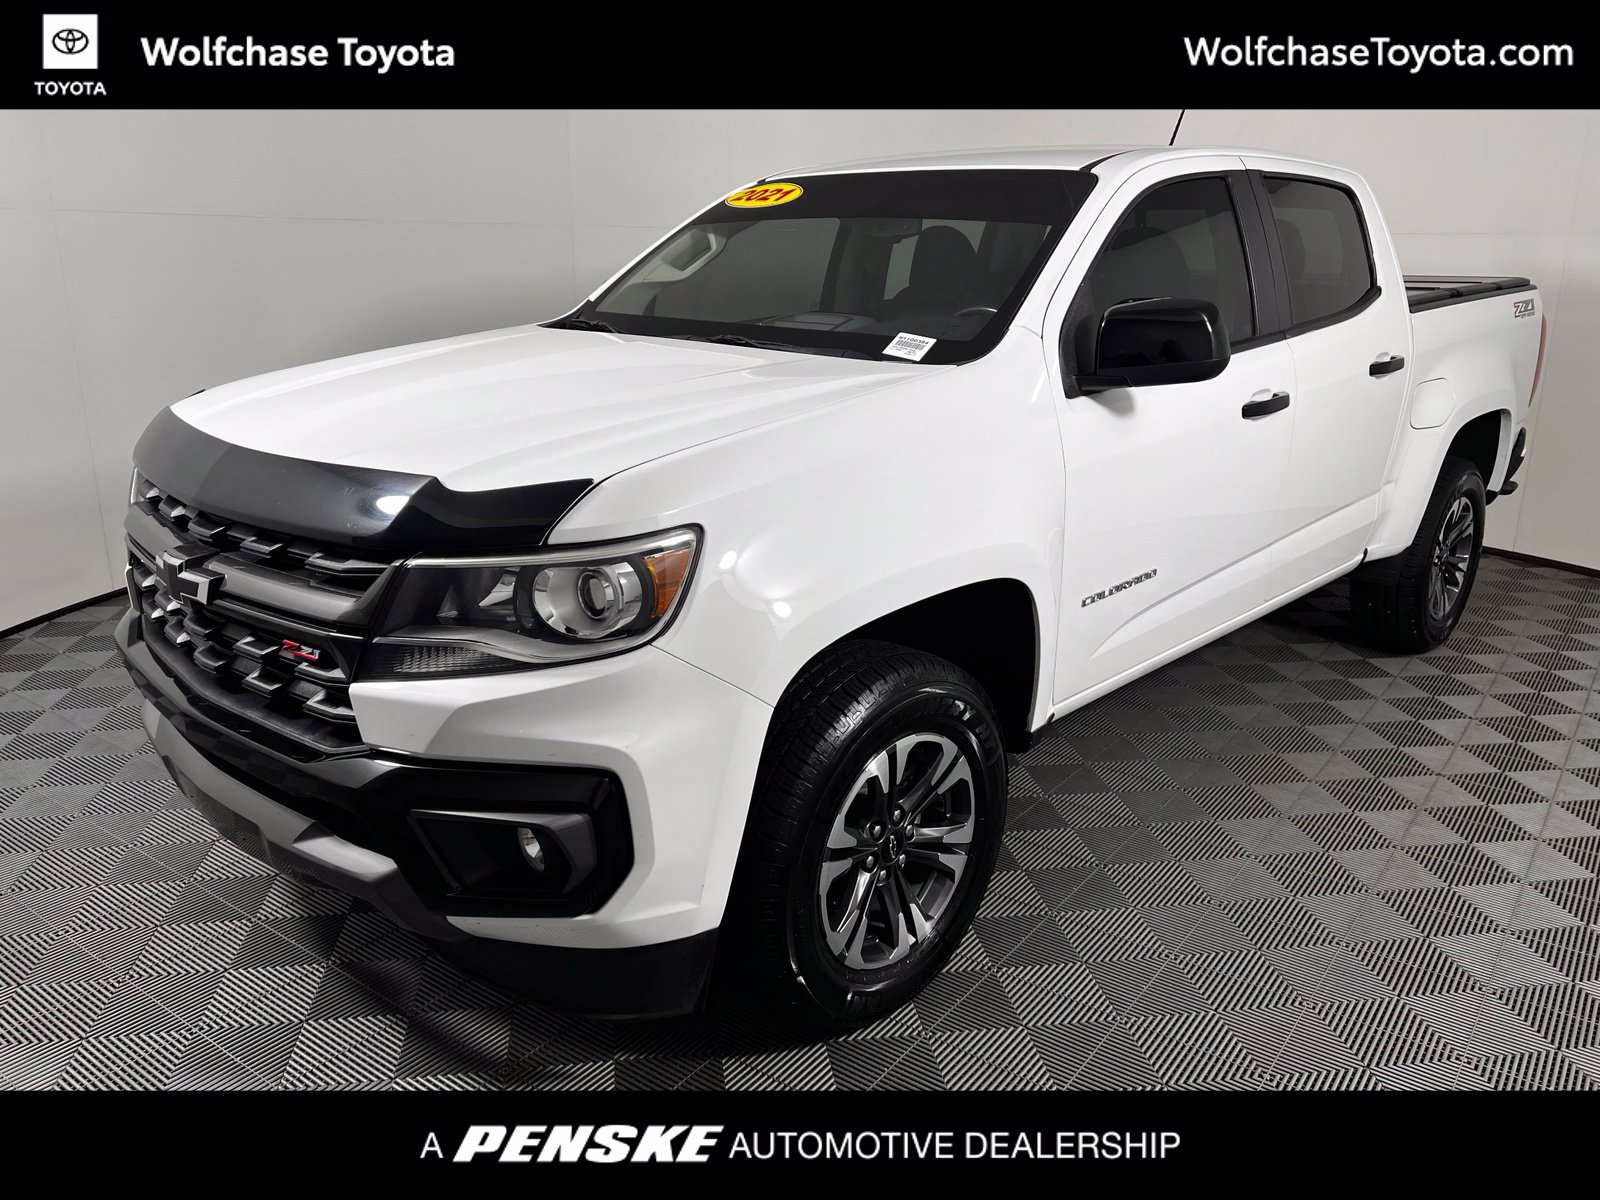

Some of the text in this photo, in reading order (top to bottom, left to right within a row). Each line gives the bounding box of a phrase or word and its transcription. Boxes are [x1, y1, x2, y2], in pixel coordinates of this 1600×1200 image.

[729, 188, 798, 202] 2021
[1081, 568, 1158, 608] COLORADO
[280, 639, 321, 662] Z71
